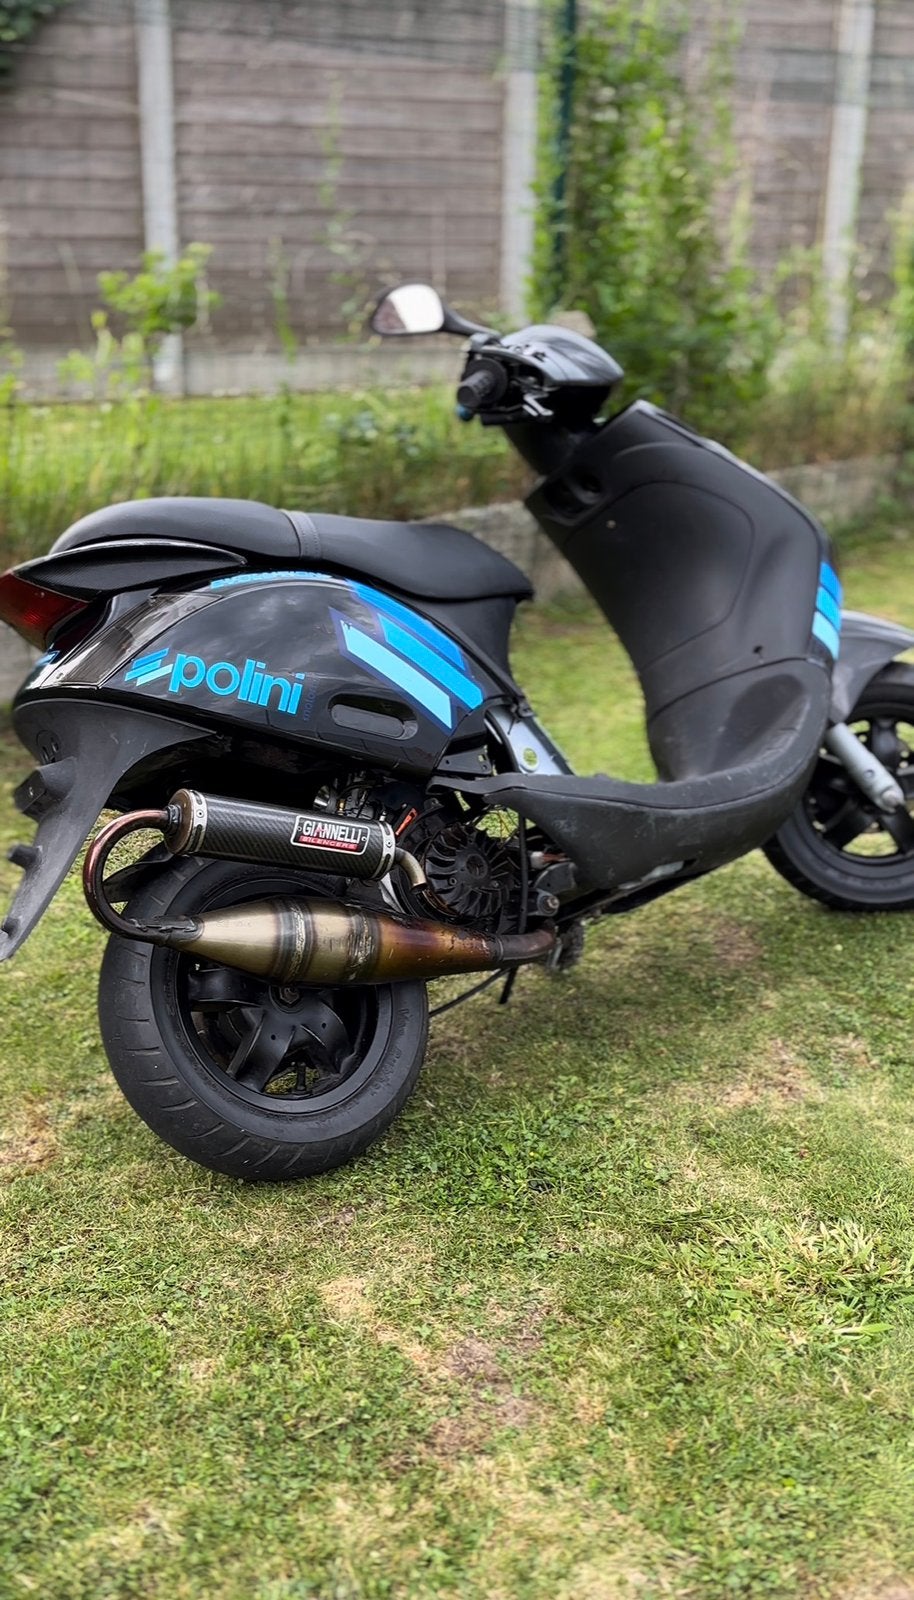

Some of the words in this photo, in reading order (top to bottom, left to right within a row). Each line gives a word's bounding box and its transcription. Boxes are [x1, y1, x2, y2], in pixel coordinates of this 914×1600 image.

[168, 653, 305, 715] polini
[301, 835, 357, 850] SILENCERS
[303, 820, 362, 843] GIANNELLI
